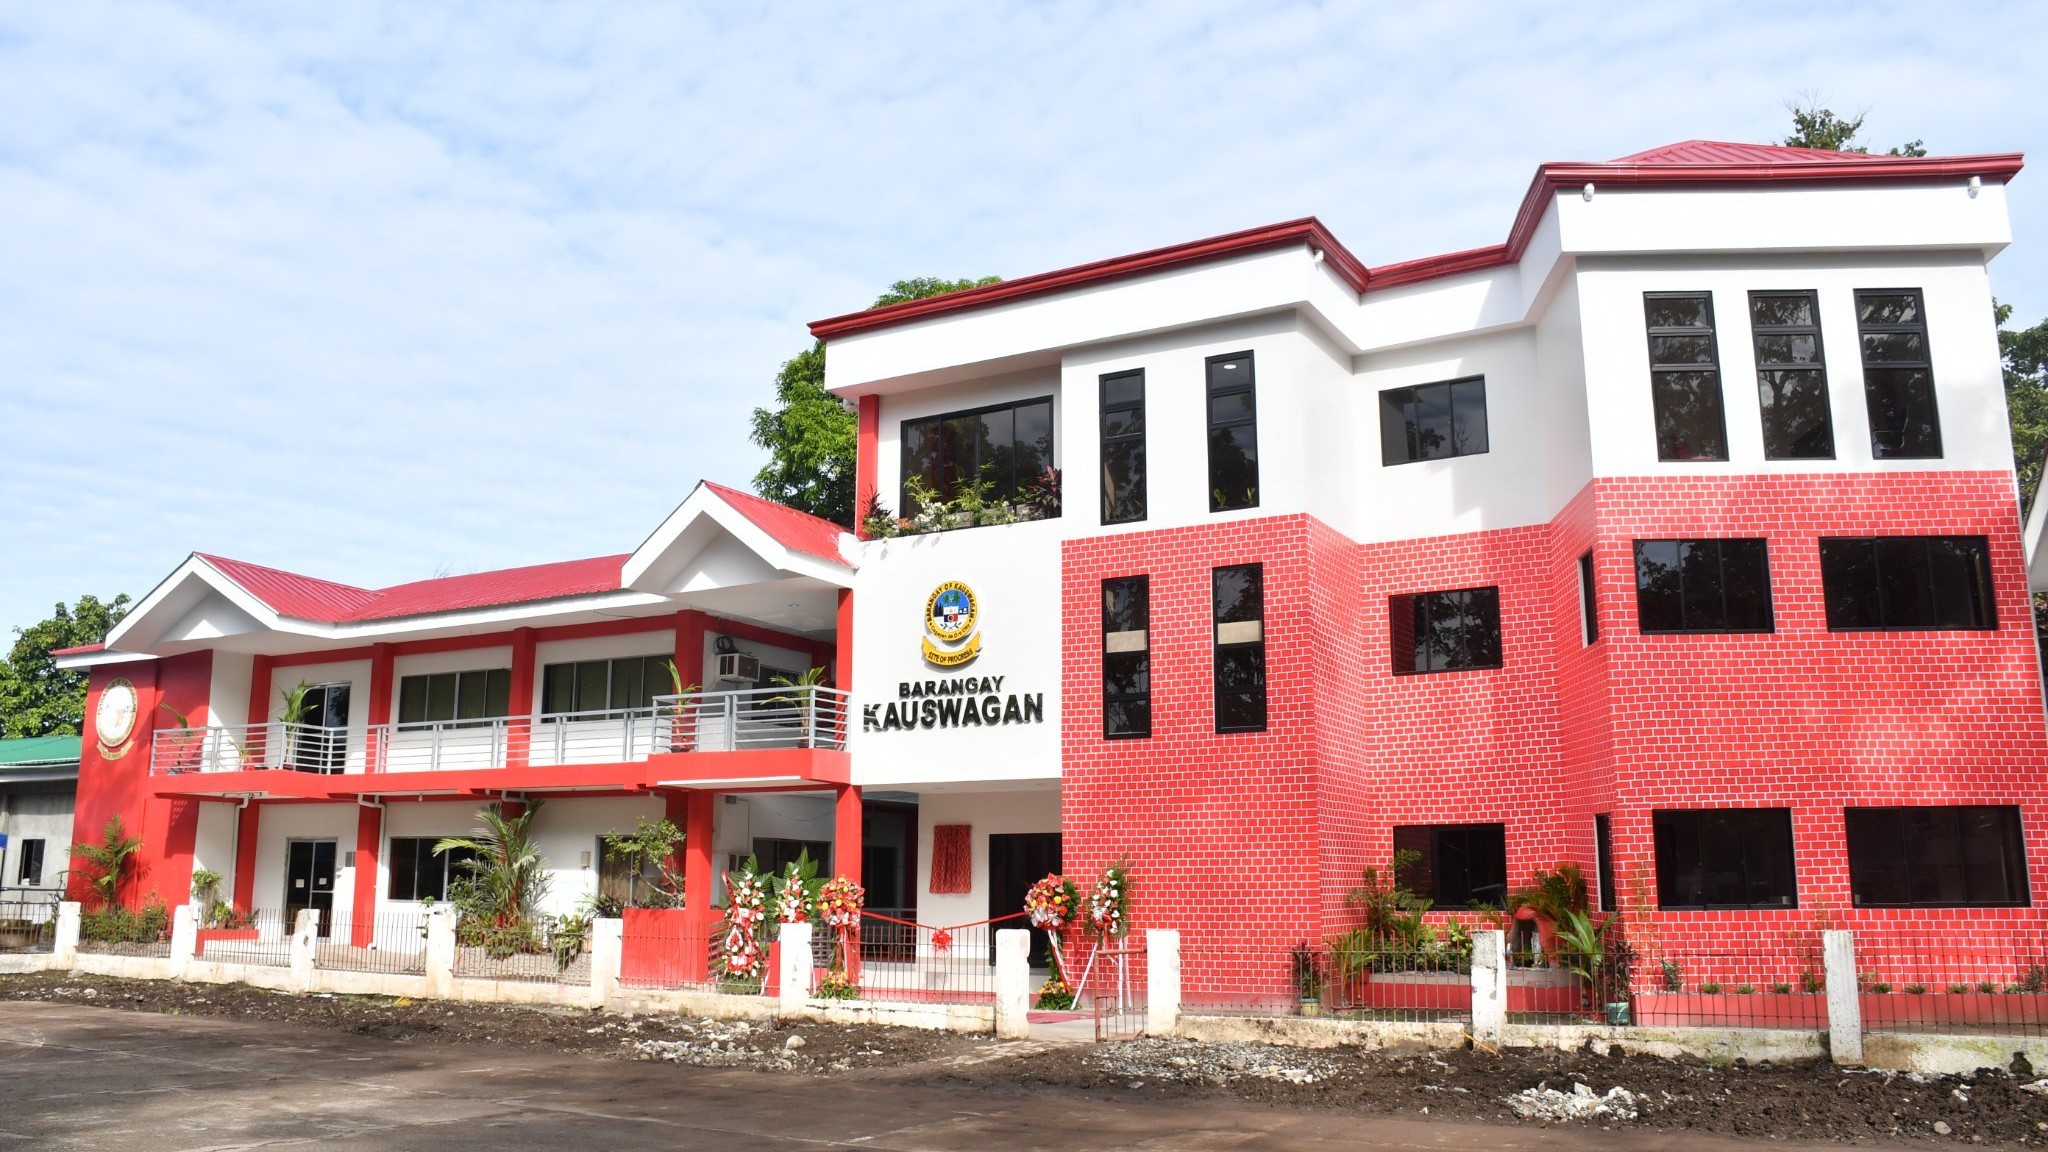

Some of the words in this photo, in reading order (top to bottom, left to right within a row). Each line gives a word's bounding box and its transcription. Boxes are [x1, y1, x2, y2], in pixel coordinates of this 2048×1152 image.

[926, 588, 942, 621] BARANGAY
[954, 583, 976, 618] KAUSWAGAN
[928, 652, 940, 661] SITE
[947, 649, 973, 663] PROGRESS
[899, 676, 1005, 697] BARANGAY
[863, 693, 1043, 732] KAUSWAGAN
